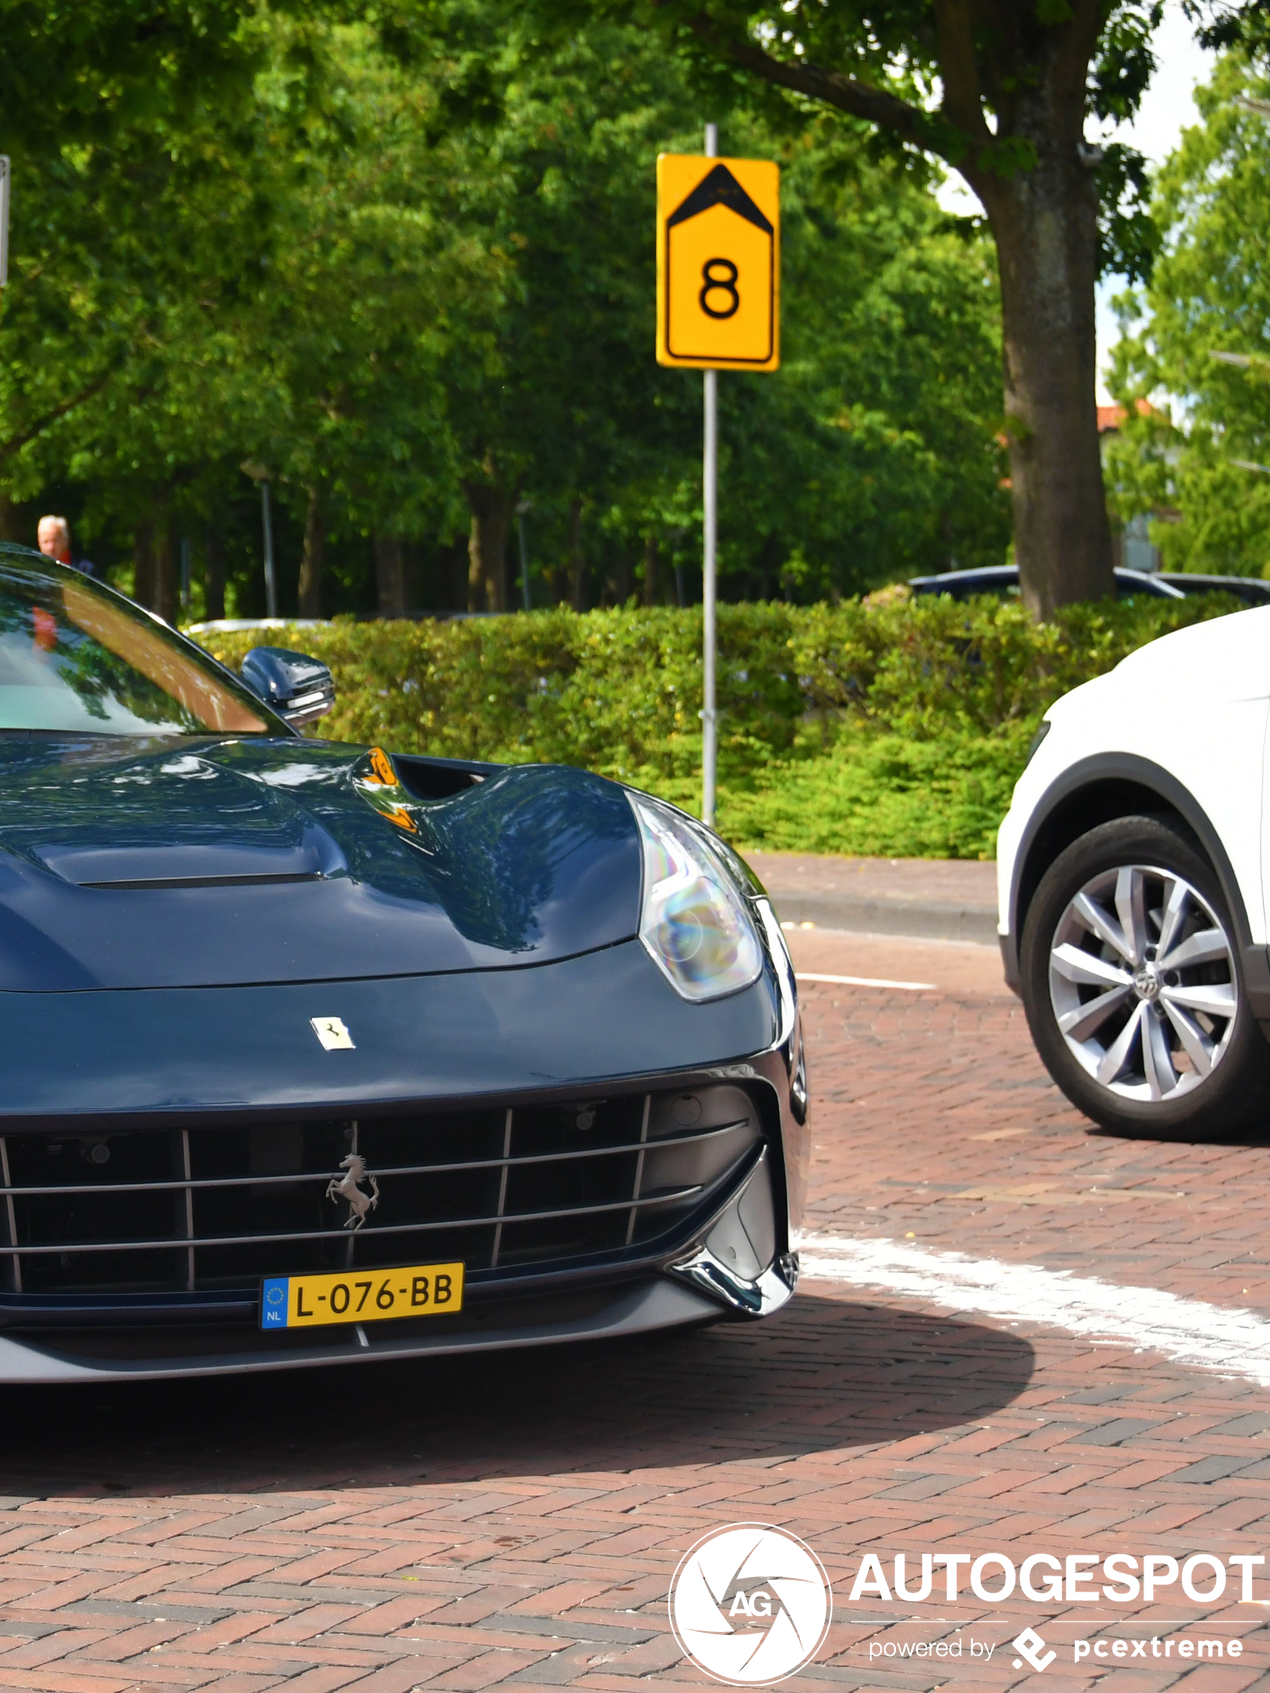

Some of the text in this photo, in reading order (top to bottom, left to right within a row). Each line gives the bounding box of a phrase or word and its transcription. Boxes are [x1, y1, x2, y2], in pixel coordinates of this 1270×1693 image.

[698, 257, 740, 320] 8
[267, 1311, 281, 1321] NL
[296, 1273, 452, 1317] L-076-BB
